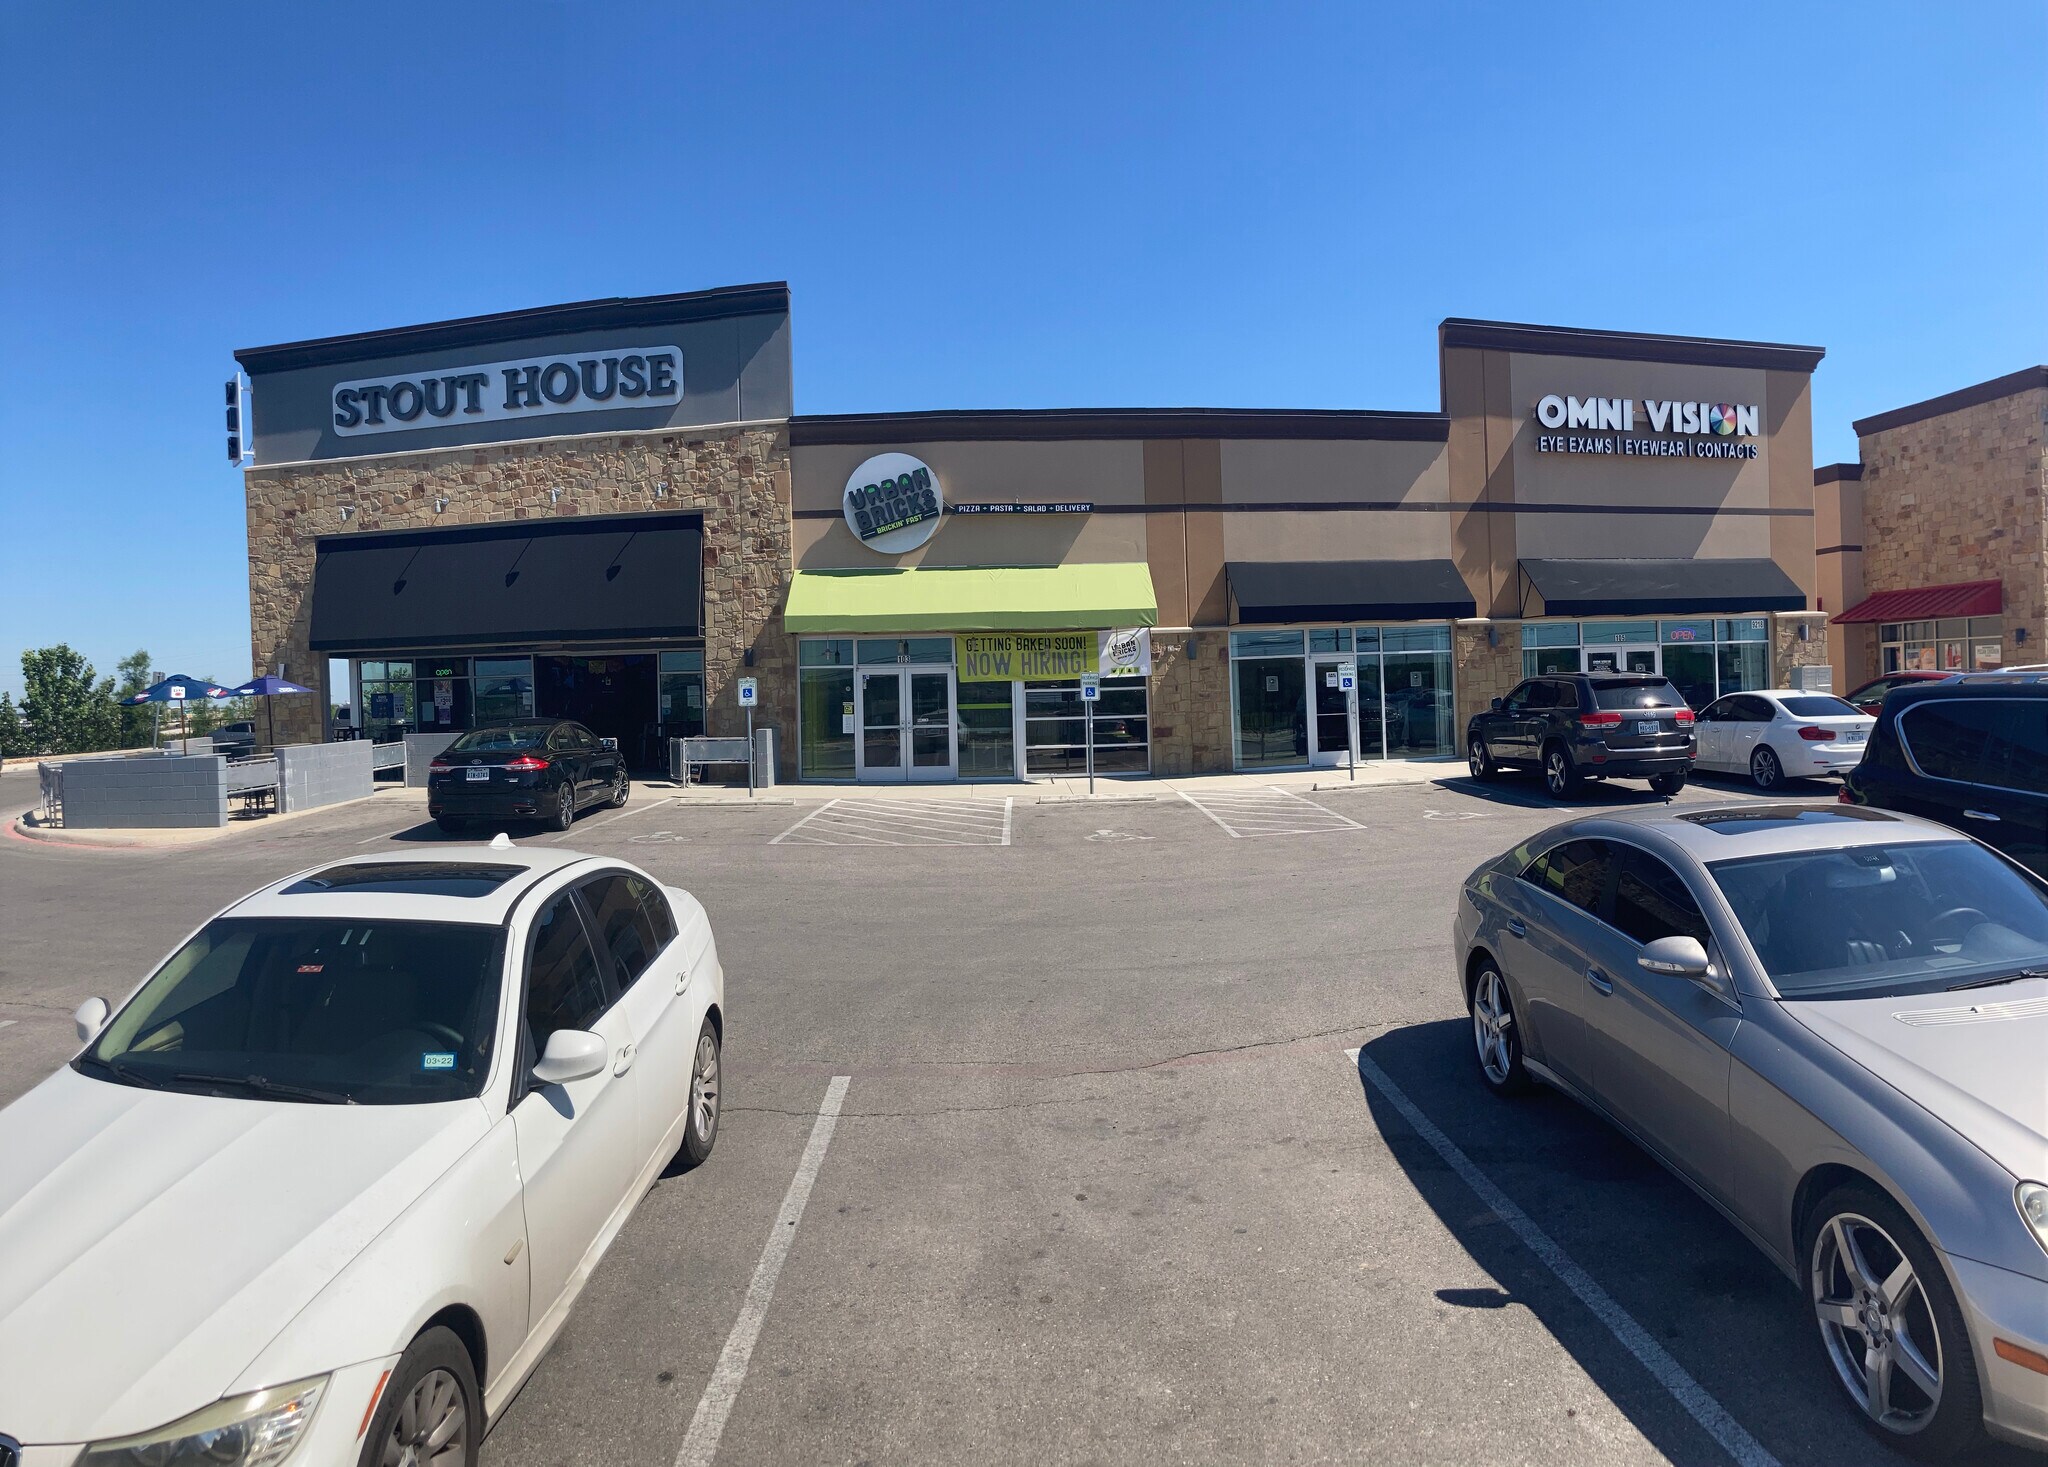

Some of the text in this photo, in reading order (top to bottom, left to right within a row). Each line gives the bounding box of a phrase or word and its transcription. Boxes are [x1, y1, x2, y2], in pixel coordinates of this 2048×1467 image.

[335, 353, 677, 428] STOUT HOUSE
[1537, 394, 1759, 436] OMNI VISION
[1539, 436, 1759, 459] EYE EXAMS EYEWEAR CONTACTS
[848, 467, 931, 510] URBAN
[854, 488, 937, 531] BRICKS
[958, 505, 980, 513] PIZZA
[989, 504, 1014, 512] PASTA
[1055, 504, 1091, 512] DELIVERY
[906, 513, 923, 525] FAST
[1670, 630, 1695, 640] OPEN
[966, 636, 1087, 652] GETTING BAKED SOON!
[1111, 640, 1136, 652] UBAN
[897, 655, 911, 663] 103
[966, 650, 1088, 676] NOW HIRING!
[435, 668, 453, 676] open
